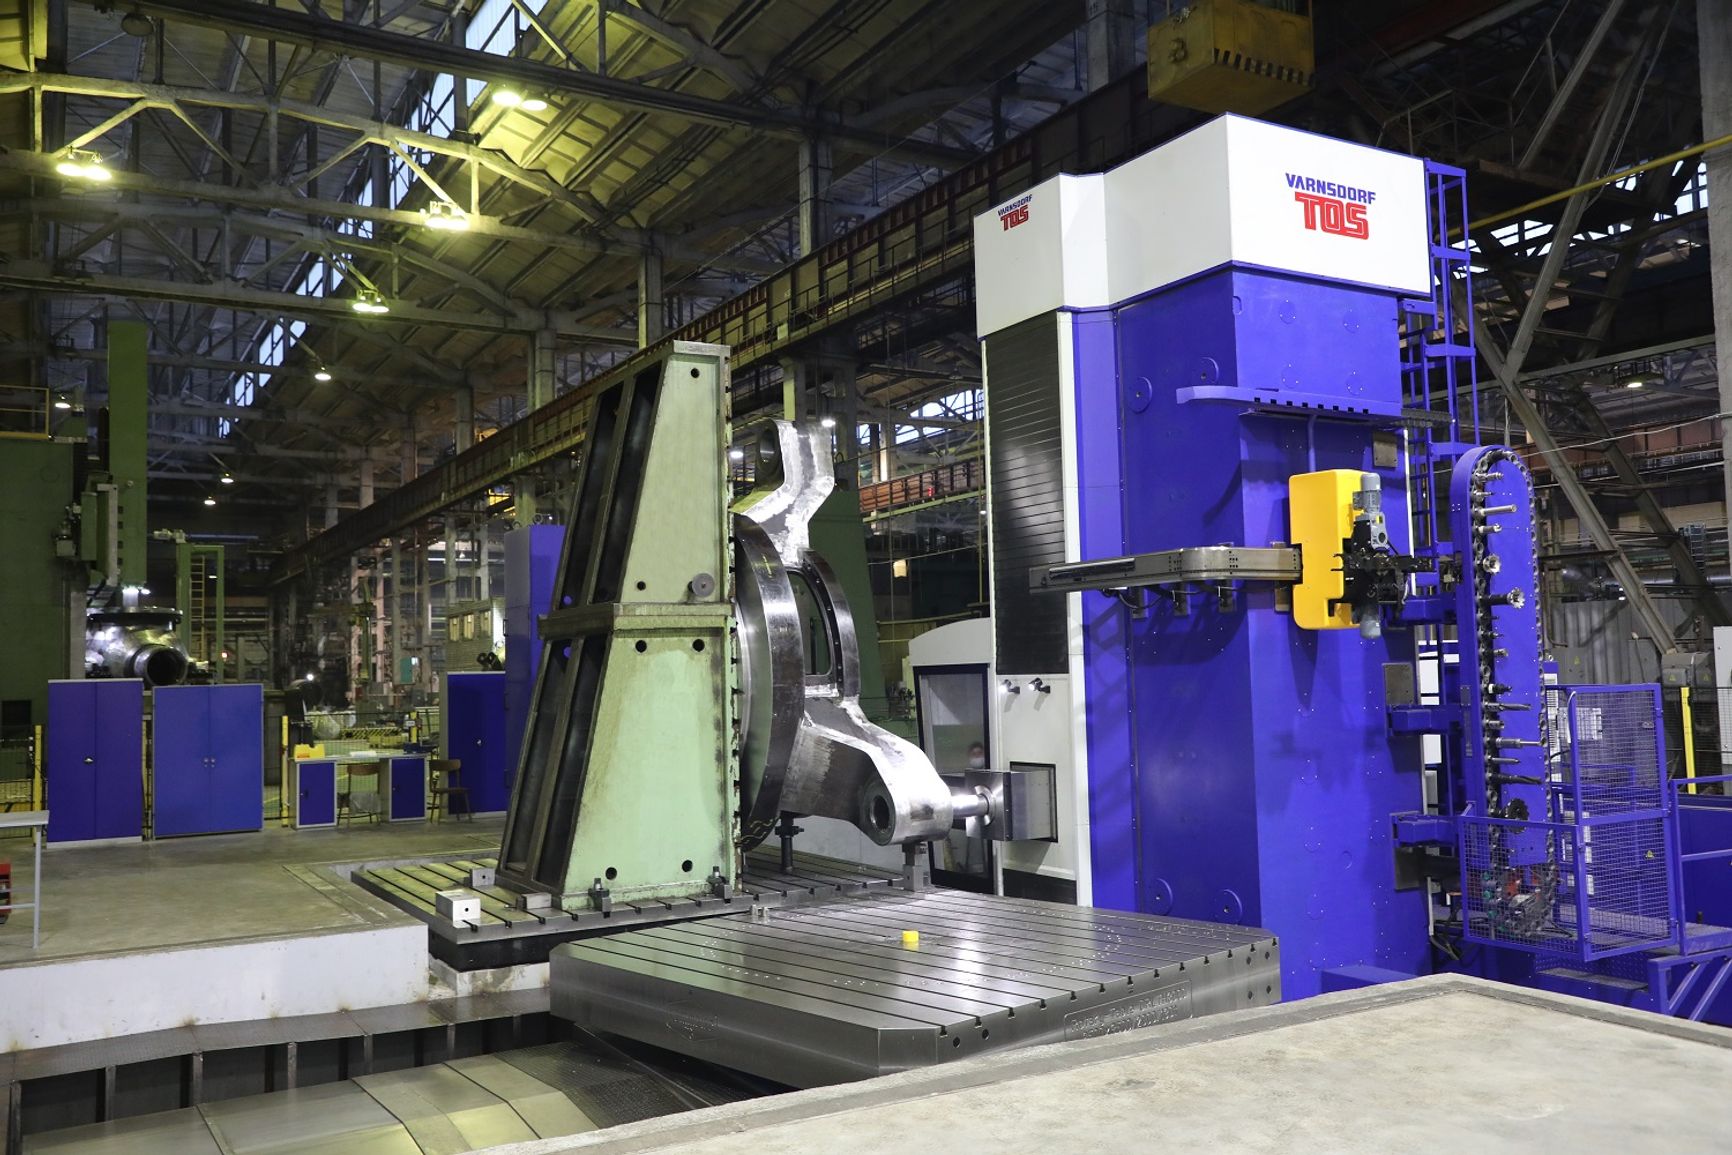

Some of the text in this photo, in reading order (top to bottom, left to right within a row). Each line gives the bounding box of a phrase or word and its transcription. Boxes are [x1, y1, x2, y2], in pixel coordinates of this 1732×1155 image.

[1285, 172, 1377, 205] VARNSDORF
[997, 194, 1033, 216] VARNSDORF
[1000, 204, 1029, 231] TOS
[1295, 191, 1370, 240] TOS
